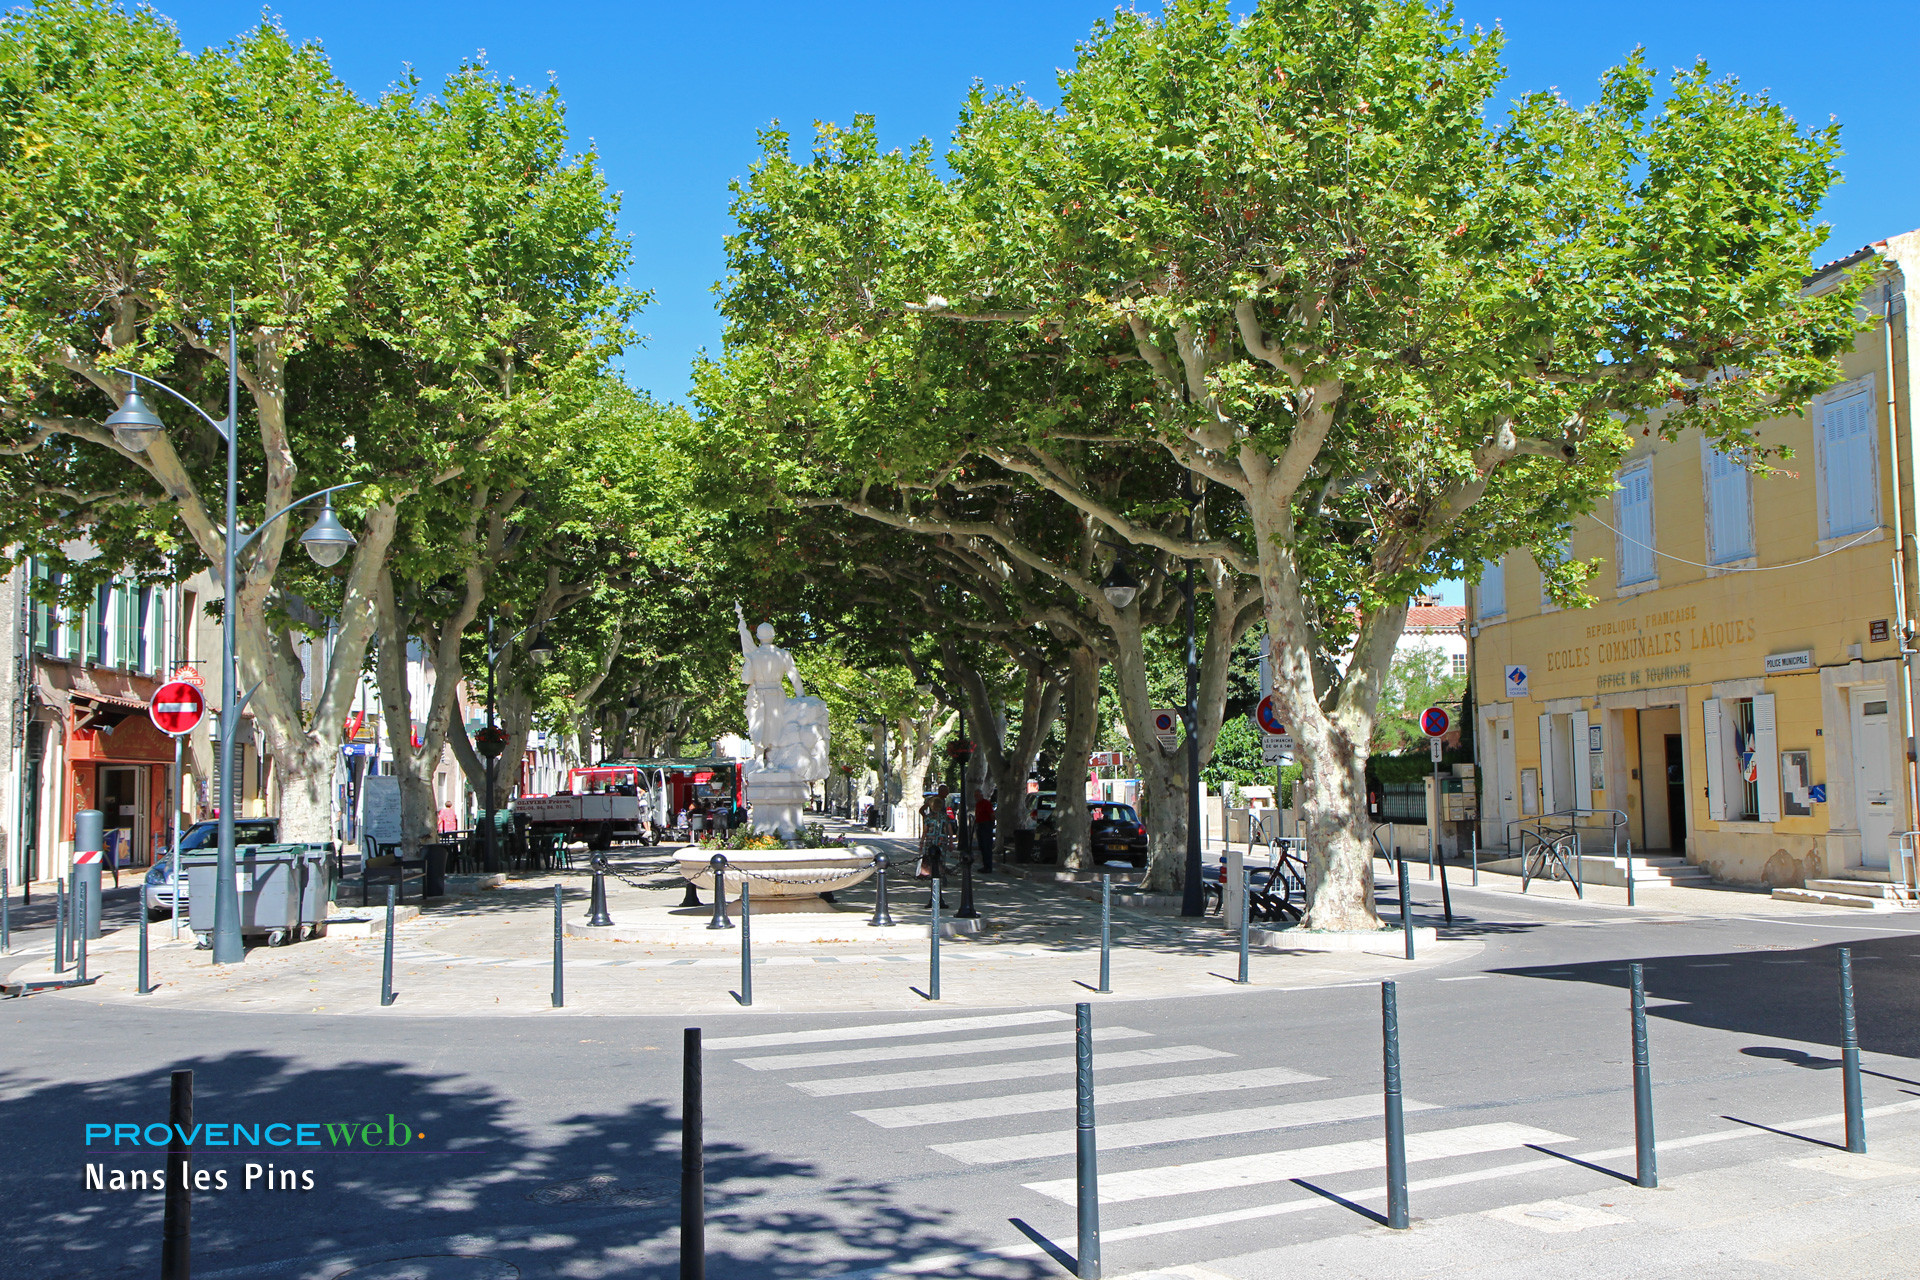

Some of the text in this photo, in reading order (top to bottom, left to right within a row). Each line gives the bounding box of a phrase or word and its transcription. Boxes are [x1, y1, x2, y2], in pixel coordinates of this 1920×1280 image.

[1586, 618, 1637, 638] REPUBLIQUE
[1547, 646, 1590, 672] ECOLES
[1598, 631, 1681, 664] COMMUNALES
[1766, 655, 1808, 668] POLICE MUNICIPALE
[1597, 662, 1691, 689] OFFICE DE TOURISME
